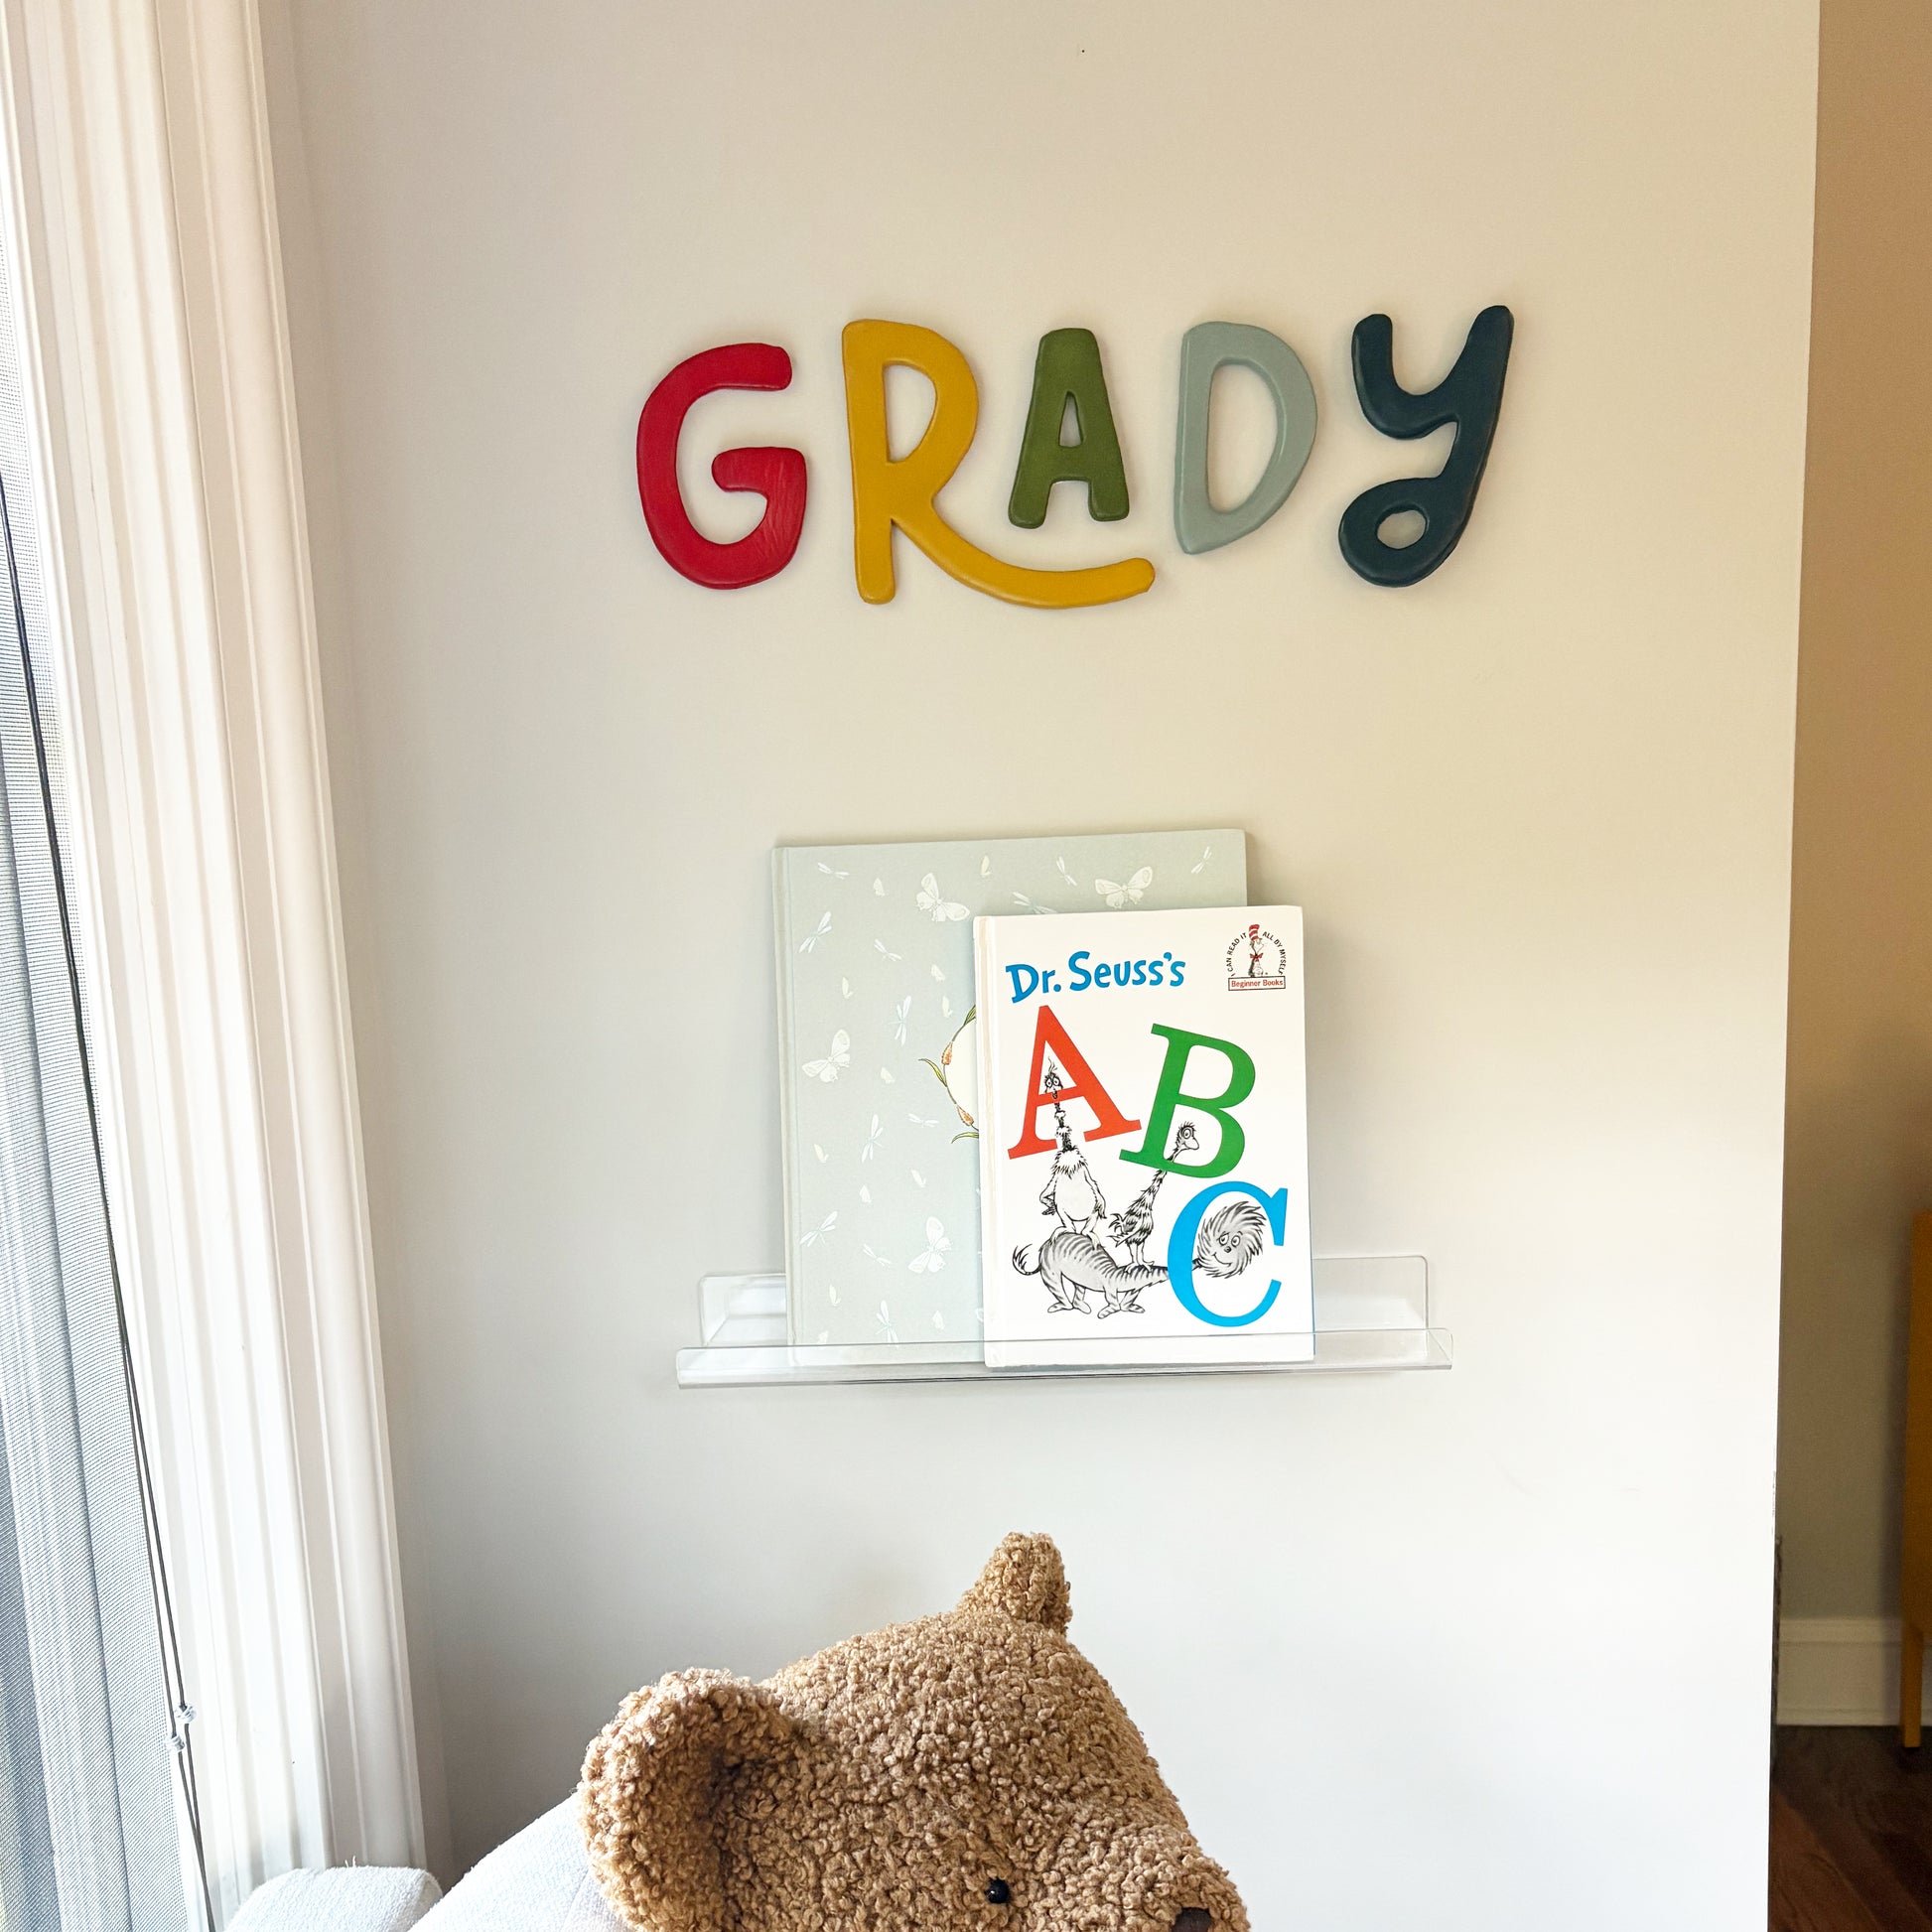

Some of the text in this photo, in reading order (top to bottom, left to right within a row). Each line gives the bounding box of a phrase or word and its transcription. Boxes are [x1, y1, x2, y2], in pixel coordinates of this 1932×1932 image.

[1262, 931, 1274, 941] ALL
[1274, 938, 1283, 948] BY
[1227, 938, 1240, 956] READ
[1278, 948, 1287, 976] MYSELF
[1005, 950, 1186, 1004] Dr. Seuss's
[1231, 979, 1261, 989] Beginner
